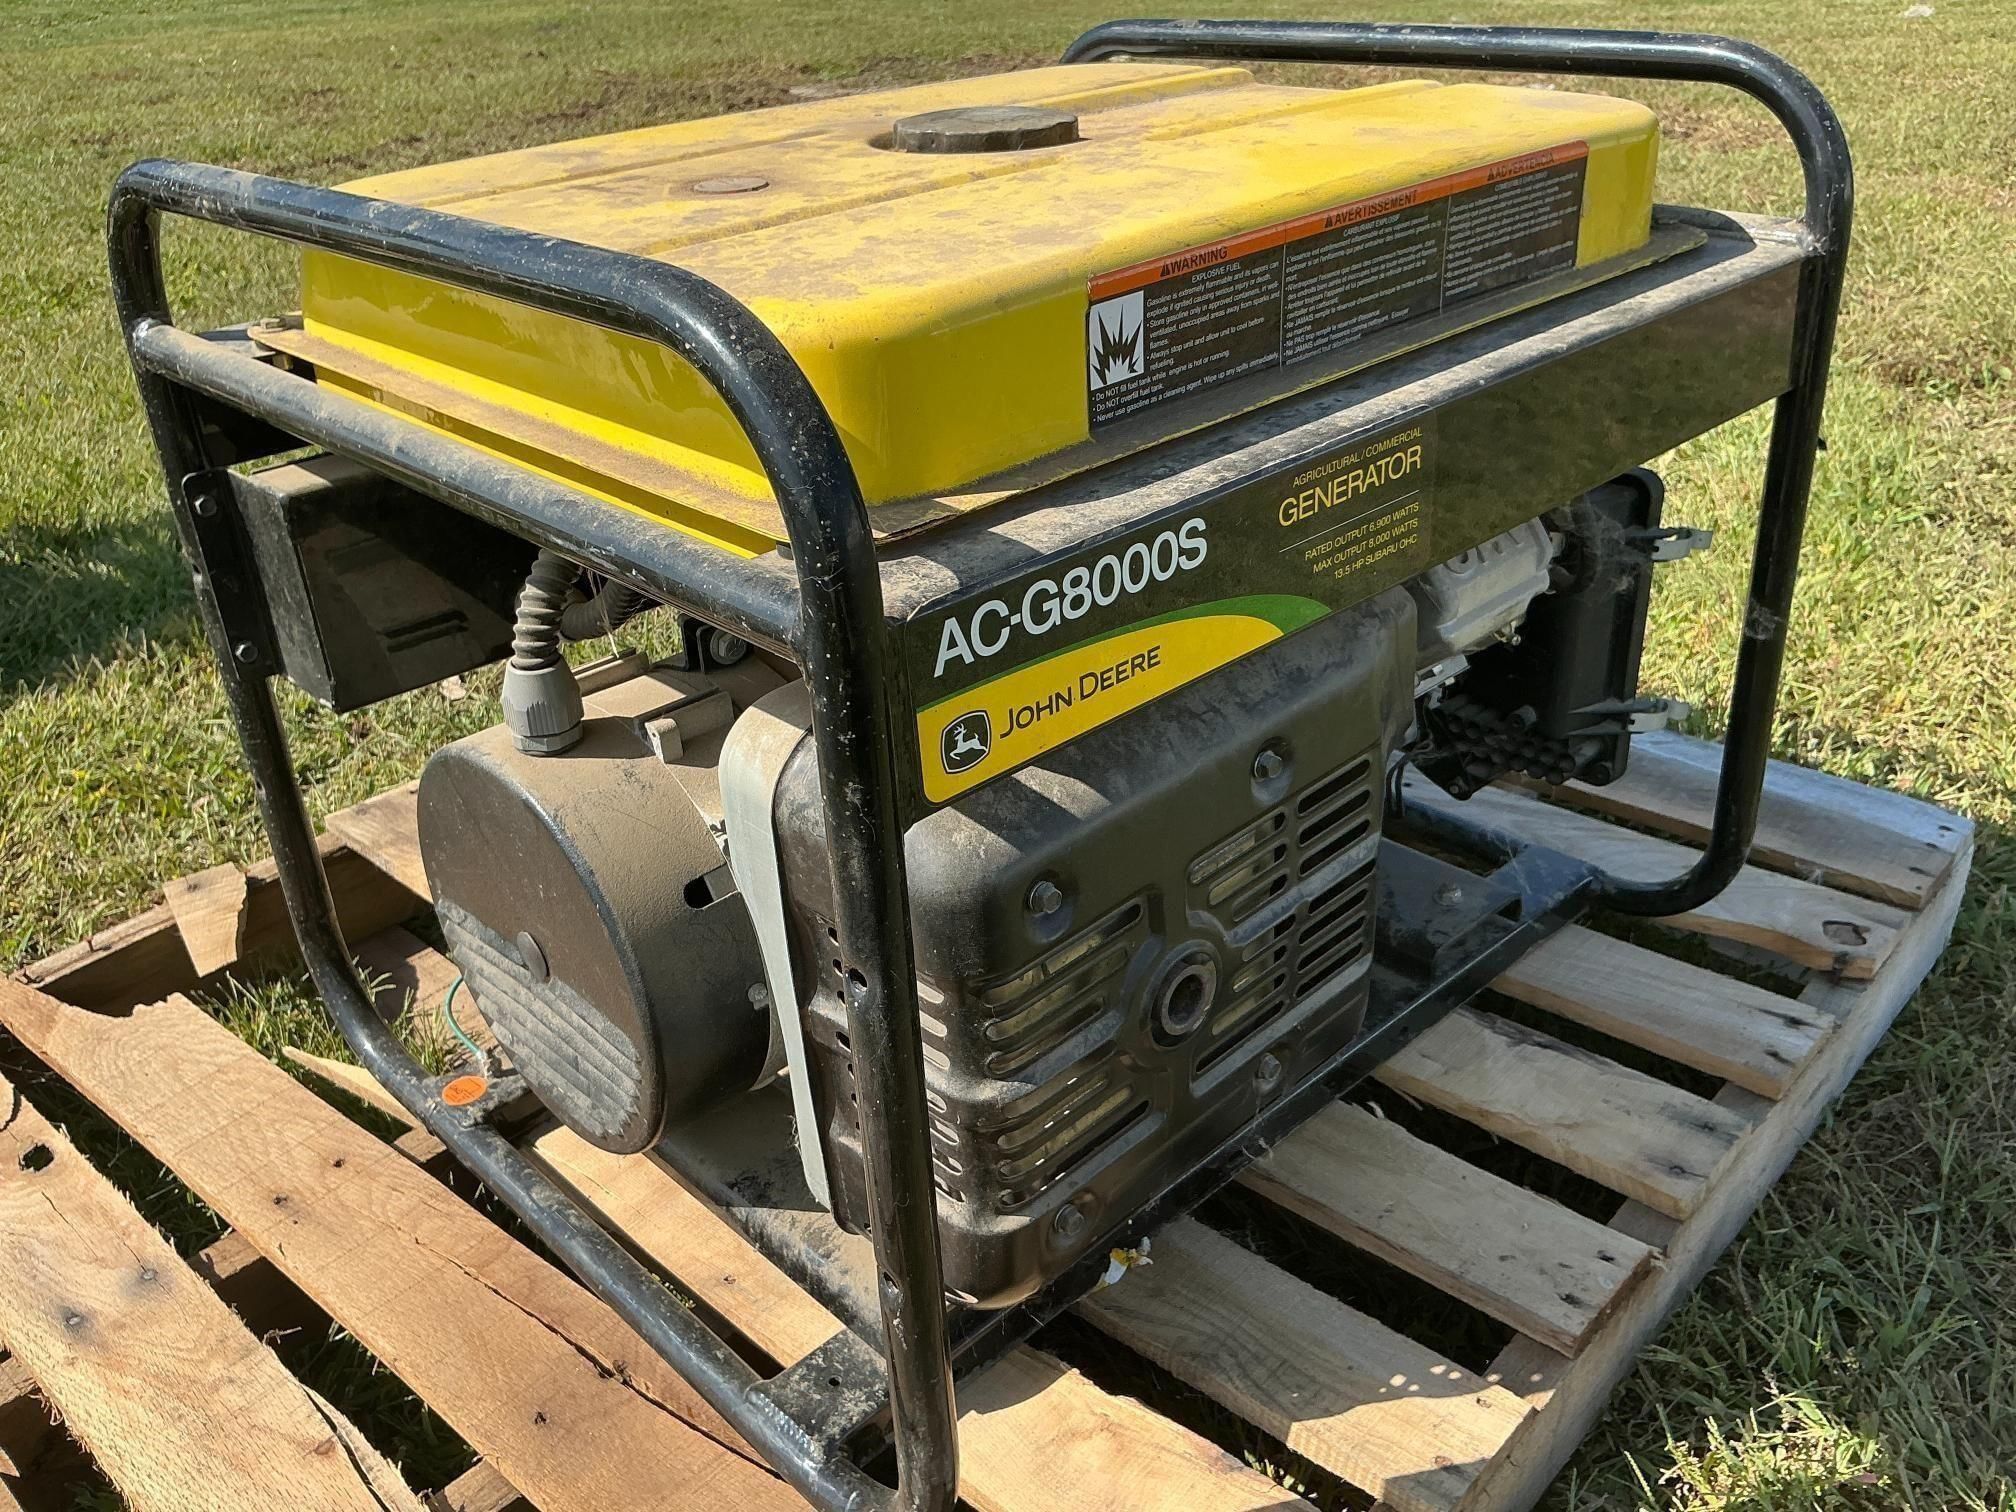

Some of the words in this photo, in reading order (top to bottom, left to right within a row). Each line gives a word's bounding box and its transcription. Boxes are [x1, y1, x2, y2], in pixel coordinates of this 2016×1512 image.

[1335, 190, 1417, 225] AVERTISSEMENT
[1147, 292, 1171, 307] Gasoline
[1179, 283, 1204, 298] extremely
[1234, 271, 1243, 280] and
[1269, 260, 1278, 269] can
[1170, 247, 1228, 275] WARNING
[1192, 267, 1222, 283] EXPLOSIVE
[1222, 261, 1240, 274] FUEL
[1147, 305, 1167, 319] explode
[1193, 291, 1213, 305] causing
[1165, 309, 1188, 324] gasoline
[1190, 305, 1201, 316] only
[1202, 303, 1207, 311] in
[1208, 295, 1232, 310] approved
[1240, 299, 1251, 309] from
[1270, 290, 1279, 299] and
[1150, 347, 1169, 360] Always
[1170, 343, 1181, 354] stop
[1183, 339, 1193, 348] unit
[1195, 335, 1204, 345] and
[1220, 327, 1229, 336] unit
[1236, 321, 1247, 330] cool
[1248, 315, 1263, 326] before
[1096, 391, 1104, 401] Do
[1105, 387, 1118, 397] NOT
[1127, 380, 1138, 390] fuel
[1169, 364, 1186, 377] engine
[1096, 410, 1114, 422] Never
[1115, 407, 1125, 416] use
[1126, 398, 1149, 413] gasoline
[1150, 395, 1156, 403] as
[1203, 373, 1215, 385] Wipe
[1217, 371, 1224, 380] up
[1225, 367, 1235, 377] any
[1096, 402, 1104, 411] Do
[1105, 397, 1119, 408] NOT
[1139, 387, 1149, 396] fuel
[1279, 445, 1421, 527] GENERATOR
[1305, 542, 1332, 561] RATED
[1334, 524, 1368, 548] OUTPUT
[1369, 514, 1391, 532] 6,900
[1392, 502, 1419, 522] WATTS
[1313, 558, 1333, 573] MAX
[1334, 541, 1368, 564] OUTPUT
[1369, 531, 1390, 548] 8,000
[1391, 518, 1418, 539] WATTS
[1334, 565, 1351, 580] 13.5
[1352, 558, 1364, 571] HP
[1365, 543, 1398, 565] SUBARU
[1399, 533, 1417, 548] OHC
[934, 517, 1208, 678] AC-G8000S
[1000, 686, 1073, 739] JOHN
[1079, 645, 1161, 701] DEERE
